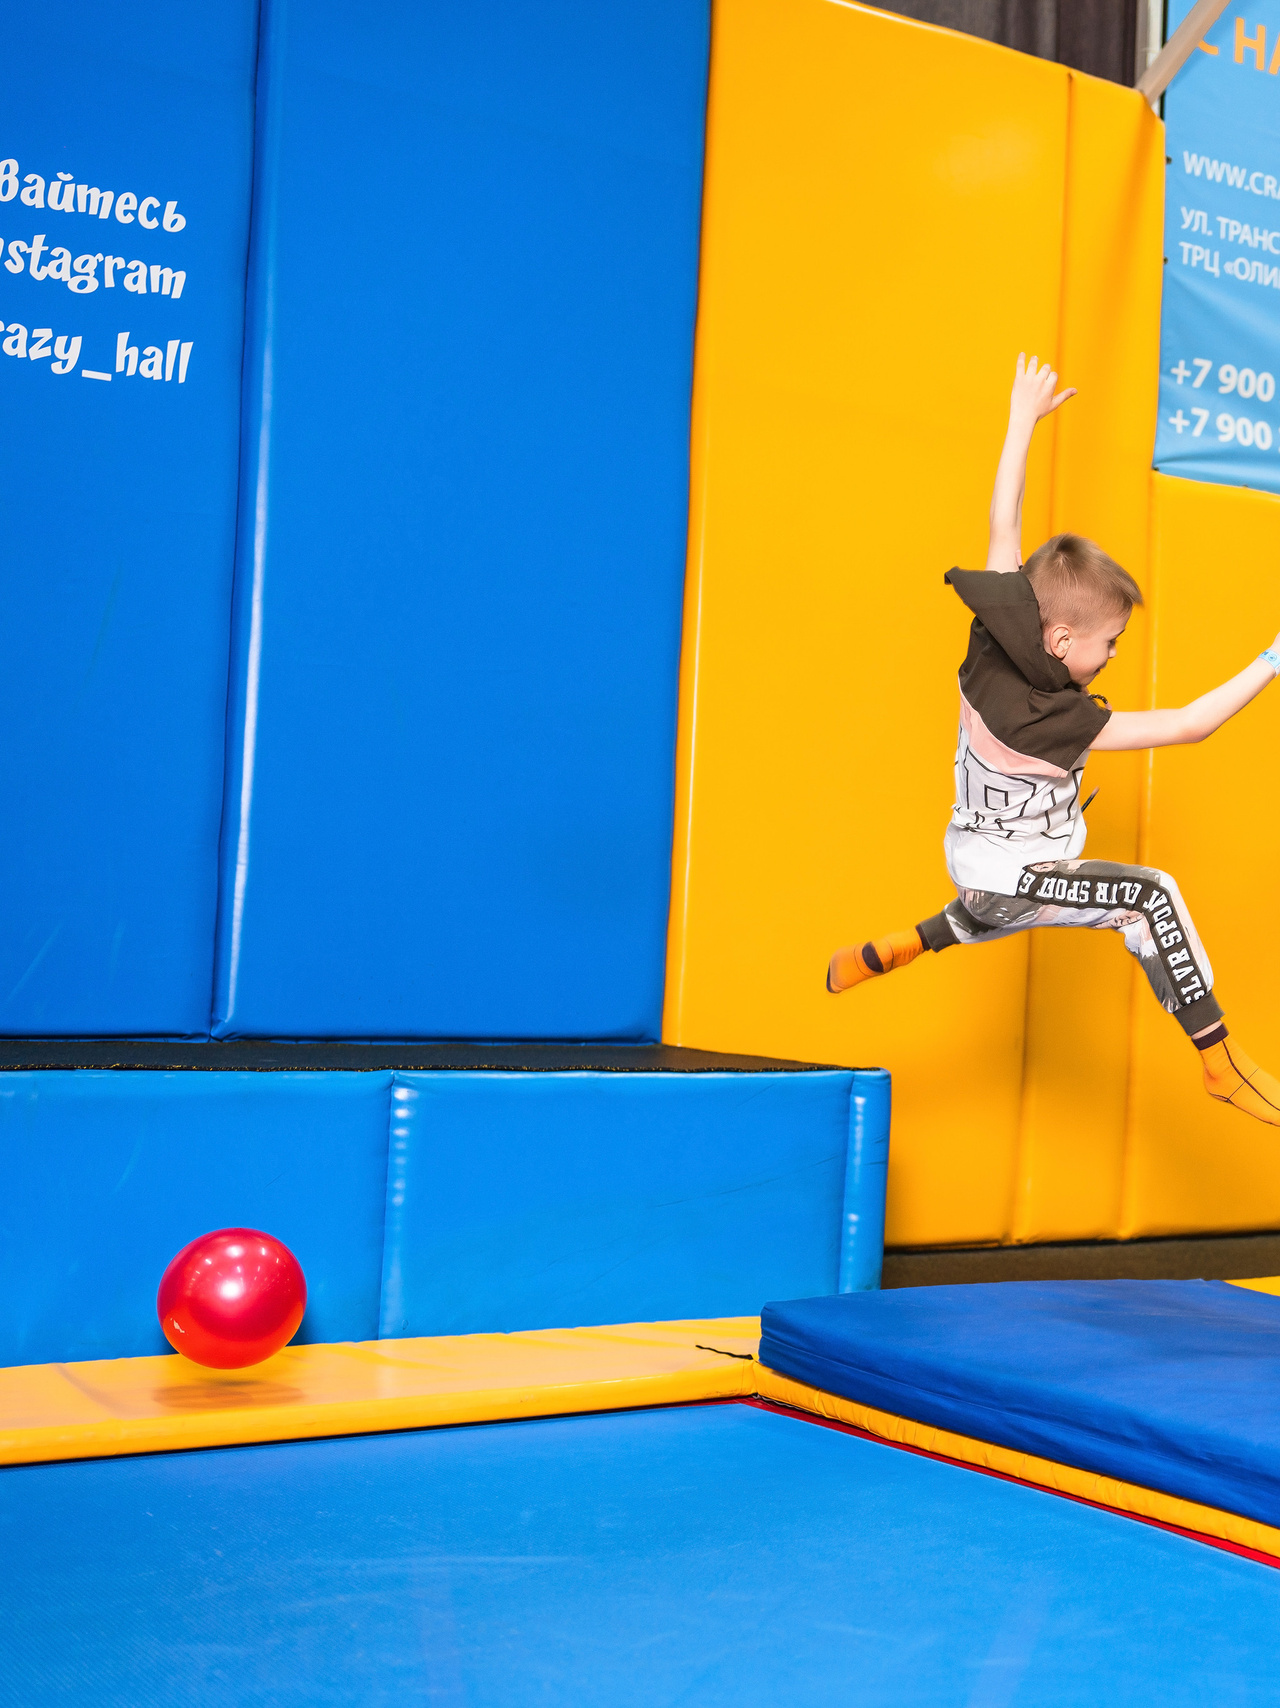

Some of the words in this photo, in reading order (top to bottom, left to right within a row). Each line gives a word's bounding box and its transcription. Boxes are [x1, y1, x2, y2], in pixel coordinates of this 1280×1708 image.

[1180, 206, 1213, 236] УЛ.
[0, 234, 187, 299] stagram
[1178, 241, 1220, 278] ТРЦ
[1170, 357, 1213, 389] +7
[1218, 364, 1275, 402] 900
[1168, 407, 1210, 437] +7
[1216, 413, 1273, 450] 900
